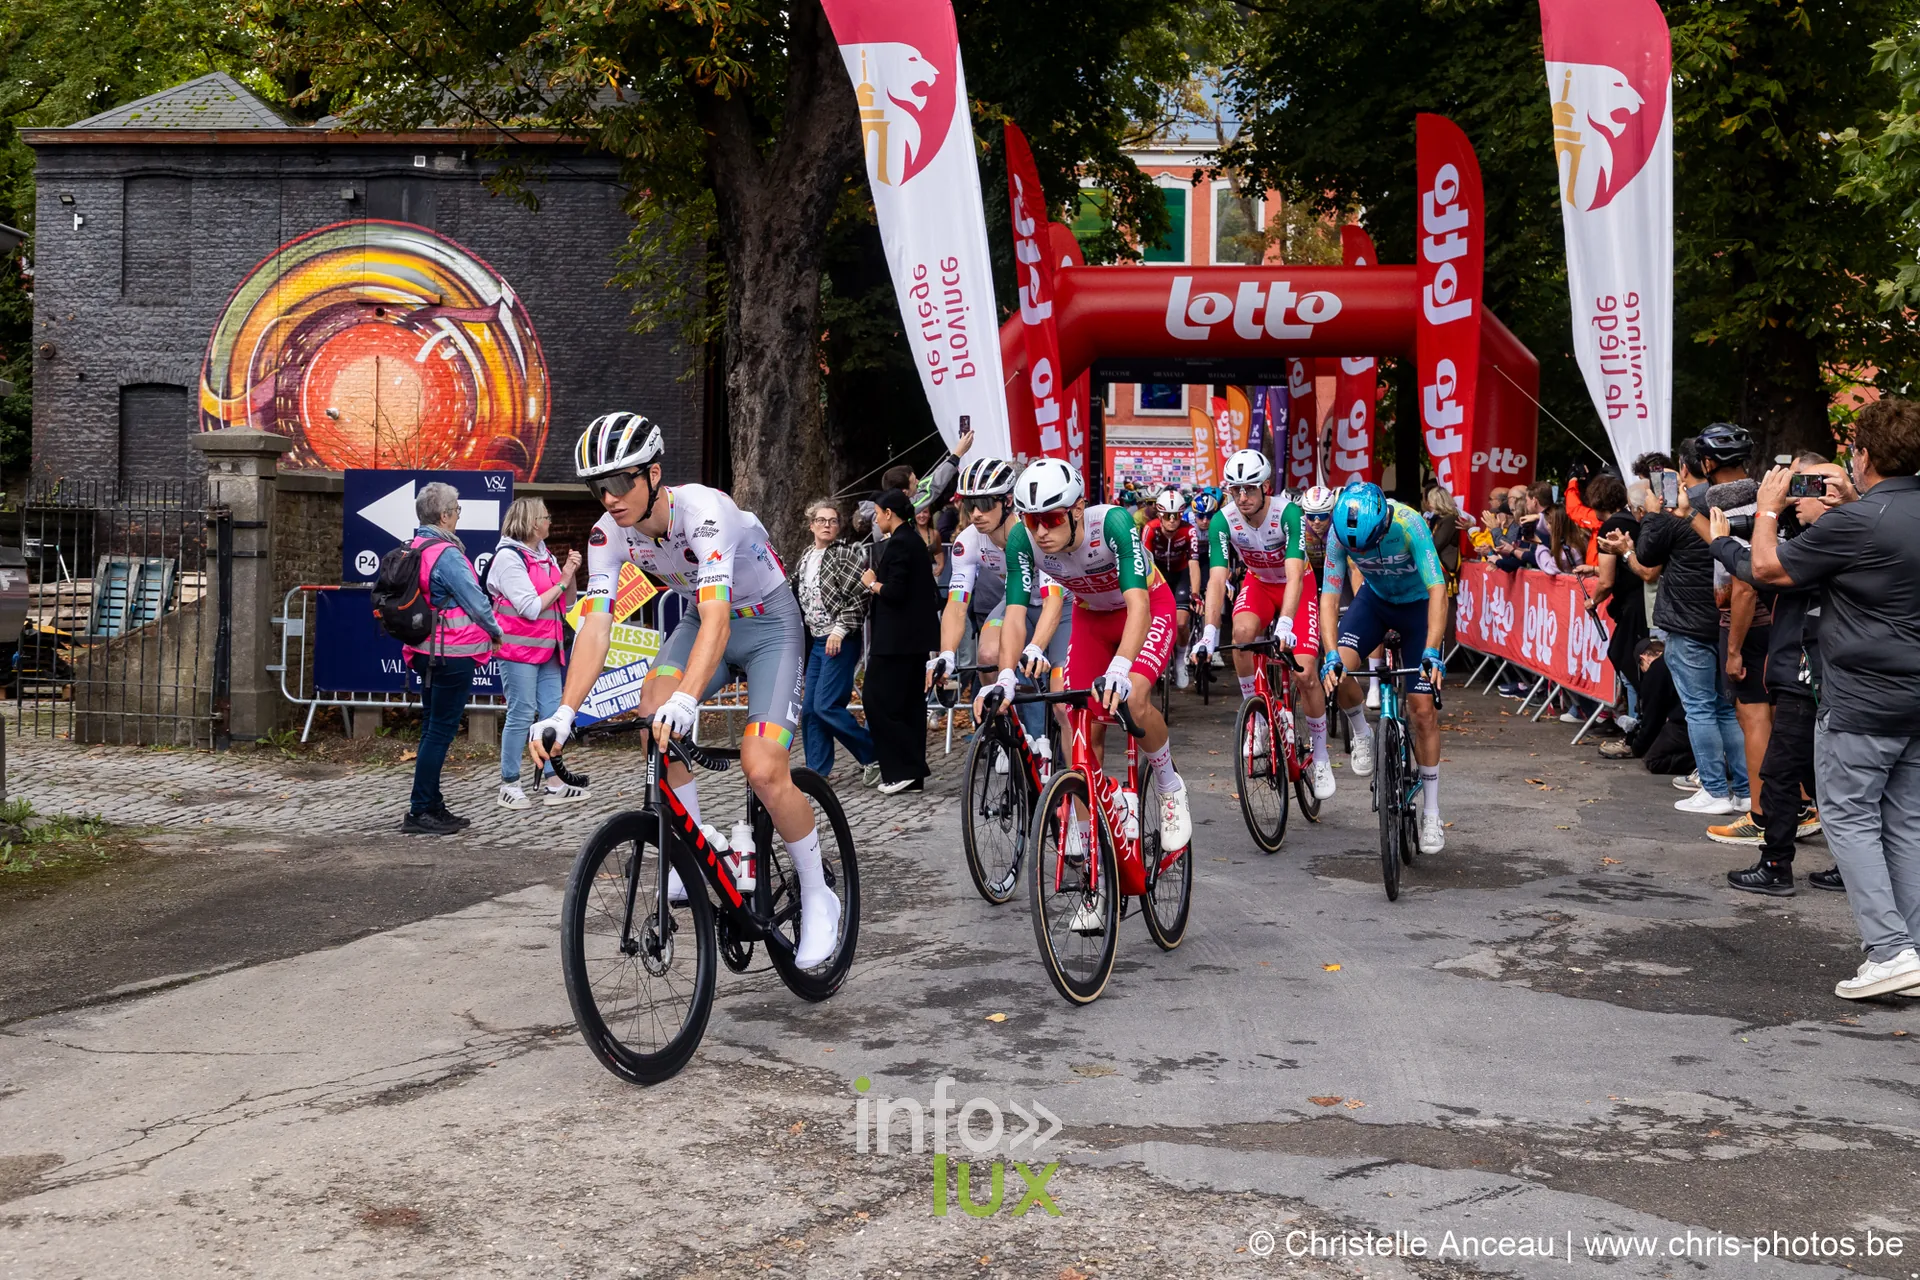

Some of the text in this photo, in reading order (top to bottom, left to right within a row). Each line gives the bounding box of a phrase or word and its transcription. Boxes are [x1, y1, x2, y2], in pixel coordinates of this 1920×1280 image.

[1471, 447, 1528, 475] otto
[358, 556, 377, 570] P4
[1130, 526, 1145, 577] KOMETA
[616, 580, 654, 617] PARKING
[1143, 615, 1168, 652] POLTI
[381, 659, 406, 673] VAL
